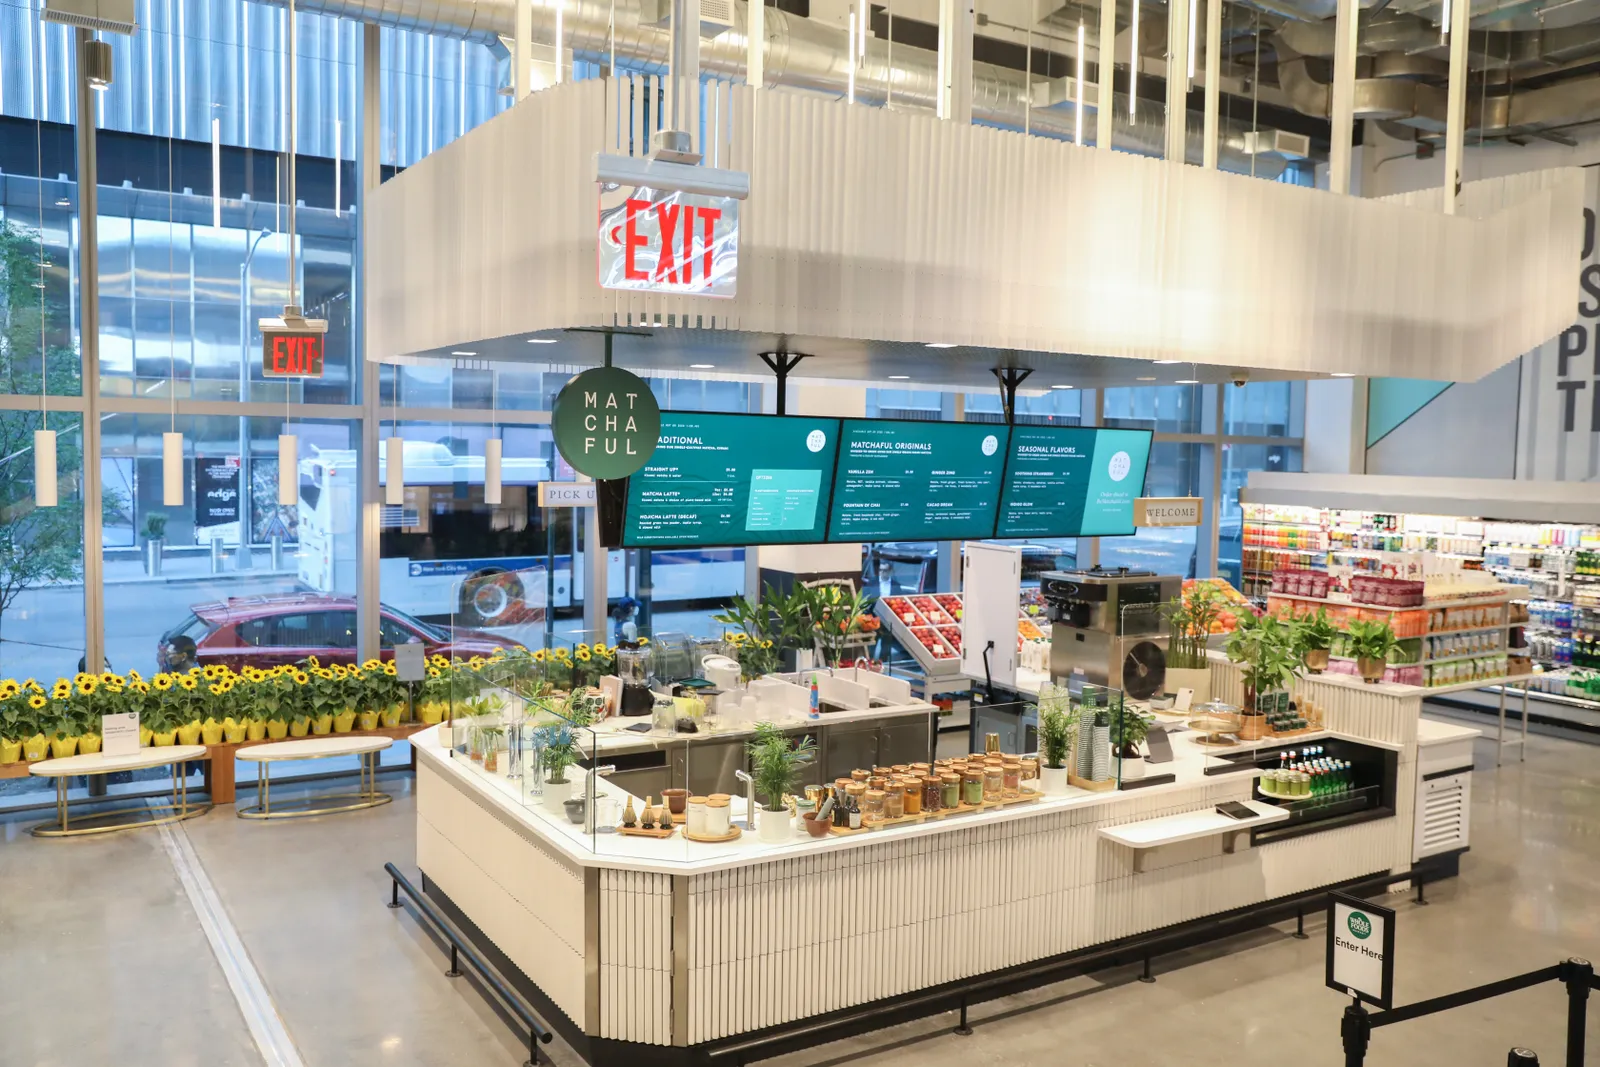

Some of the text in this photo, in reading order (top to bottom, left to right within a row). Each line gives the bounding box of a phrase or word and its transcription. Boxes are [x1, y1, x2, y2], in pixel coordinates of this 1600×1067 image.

[624, 198, 722, 287] EXIT
[272, 336, 317, 374] EXIT
[584, 391, 638, 409] MAT
[584, 414, 638, 432] CHA
[584, 437, 637, 454] FUL
[657, 436, 703, 444] ADITIONAL
[850, 441, 932, 451] MATCHAFUL ORIGINALS
[1018, 445, 1049, 453] SEASONAL
[207, 488, 237, 501] edge
[549, 490, 596, 499] PICK U
[1147, 508, 1196, 517] WELCOME
[1350, 916, 1370, 927] WHOLE
[1350, 921, 1369, 933] FOODS
[1335, 936, 1384, 961] Enter Here
